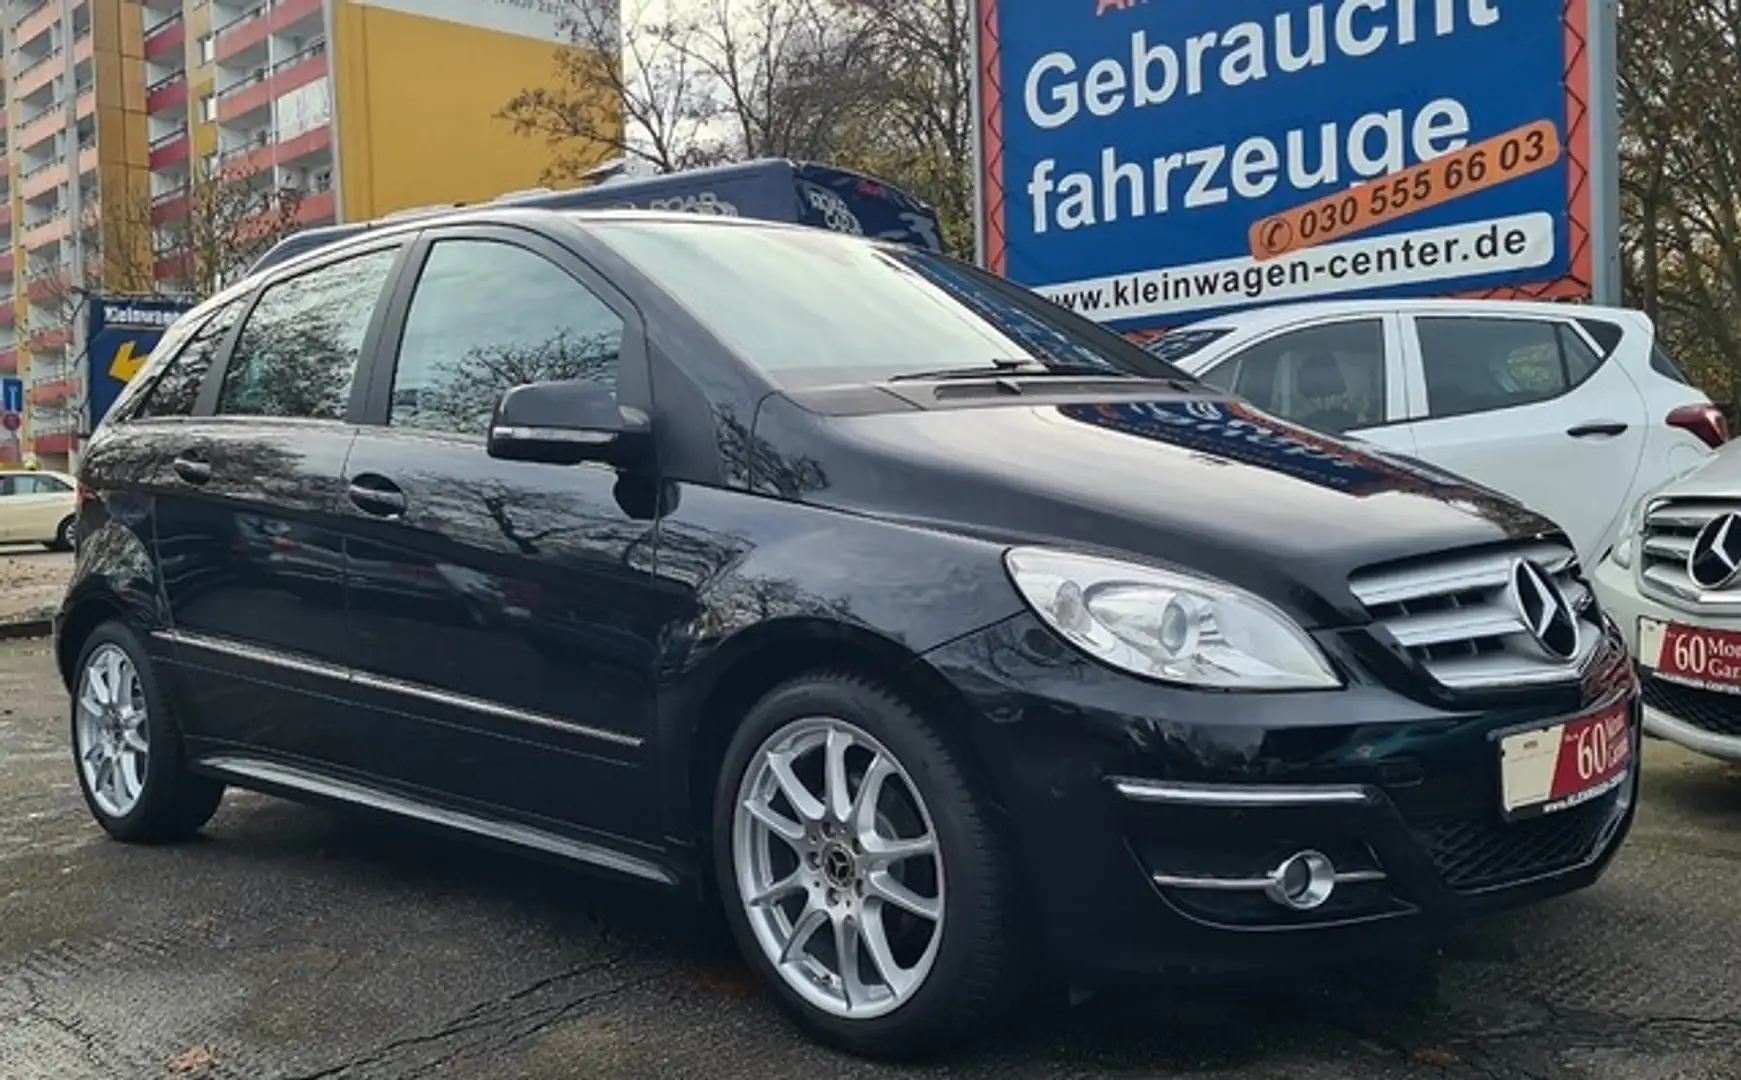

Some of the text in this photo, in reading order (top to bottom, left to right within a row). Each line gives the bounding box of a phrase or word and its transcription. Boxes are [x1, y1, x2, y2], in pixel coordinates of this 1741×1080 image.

[1028, 97, 1471, 233] fahrzeuge
[1300, 129, 1544, 239] 030 555 66 03
[1675, 634, 1706, 673] 60
[1577, 723, 1606, 779] 60
